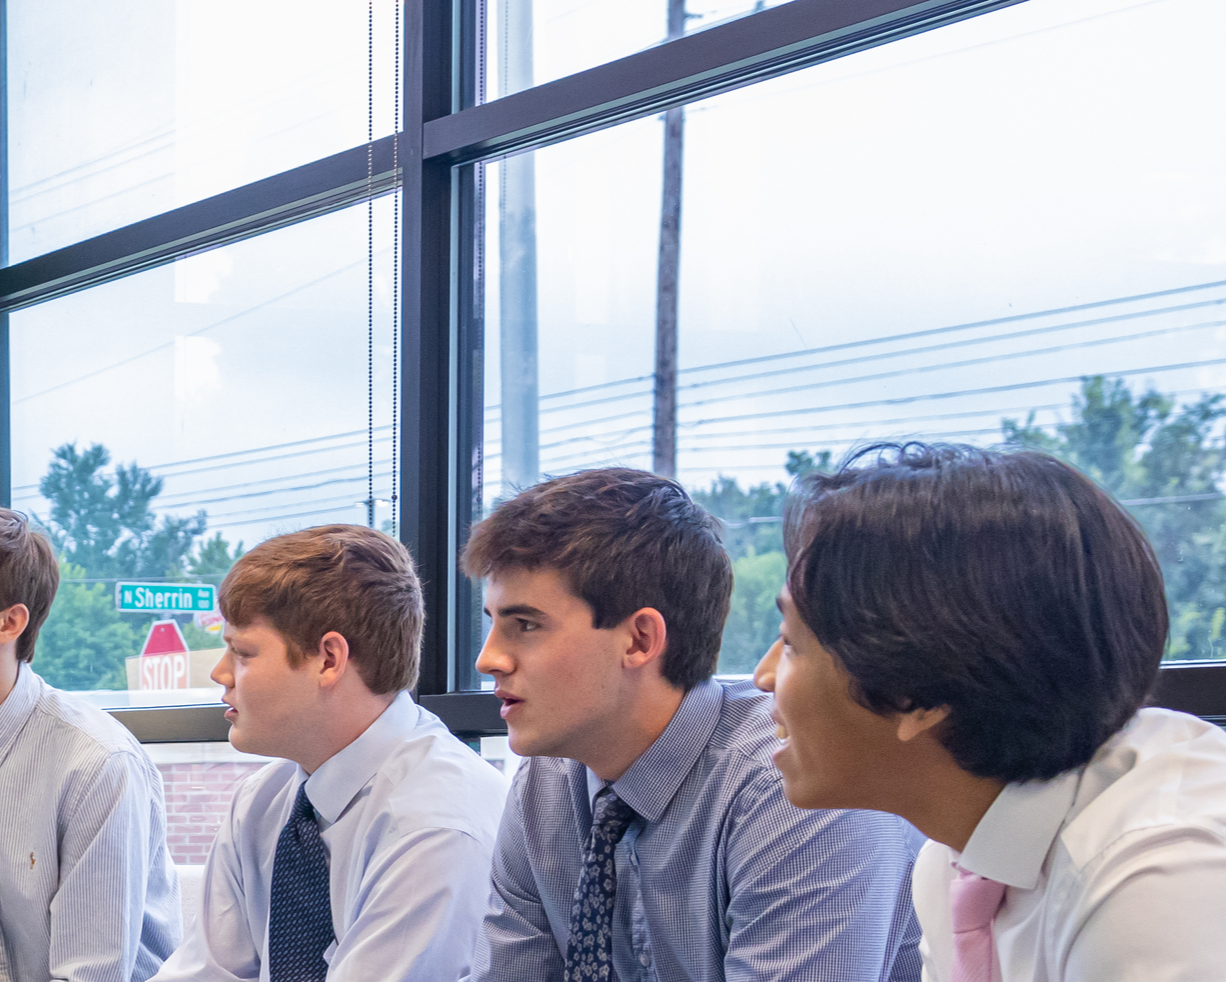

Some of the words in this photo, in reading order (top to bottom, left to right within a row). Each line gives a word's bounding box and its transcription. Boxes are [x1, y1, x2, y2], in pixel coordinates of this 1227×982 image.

[124, 590, 133, 604] N
[134, 587, 193, 608] Sherrin
[143, 654, 186, 690] STOP
